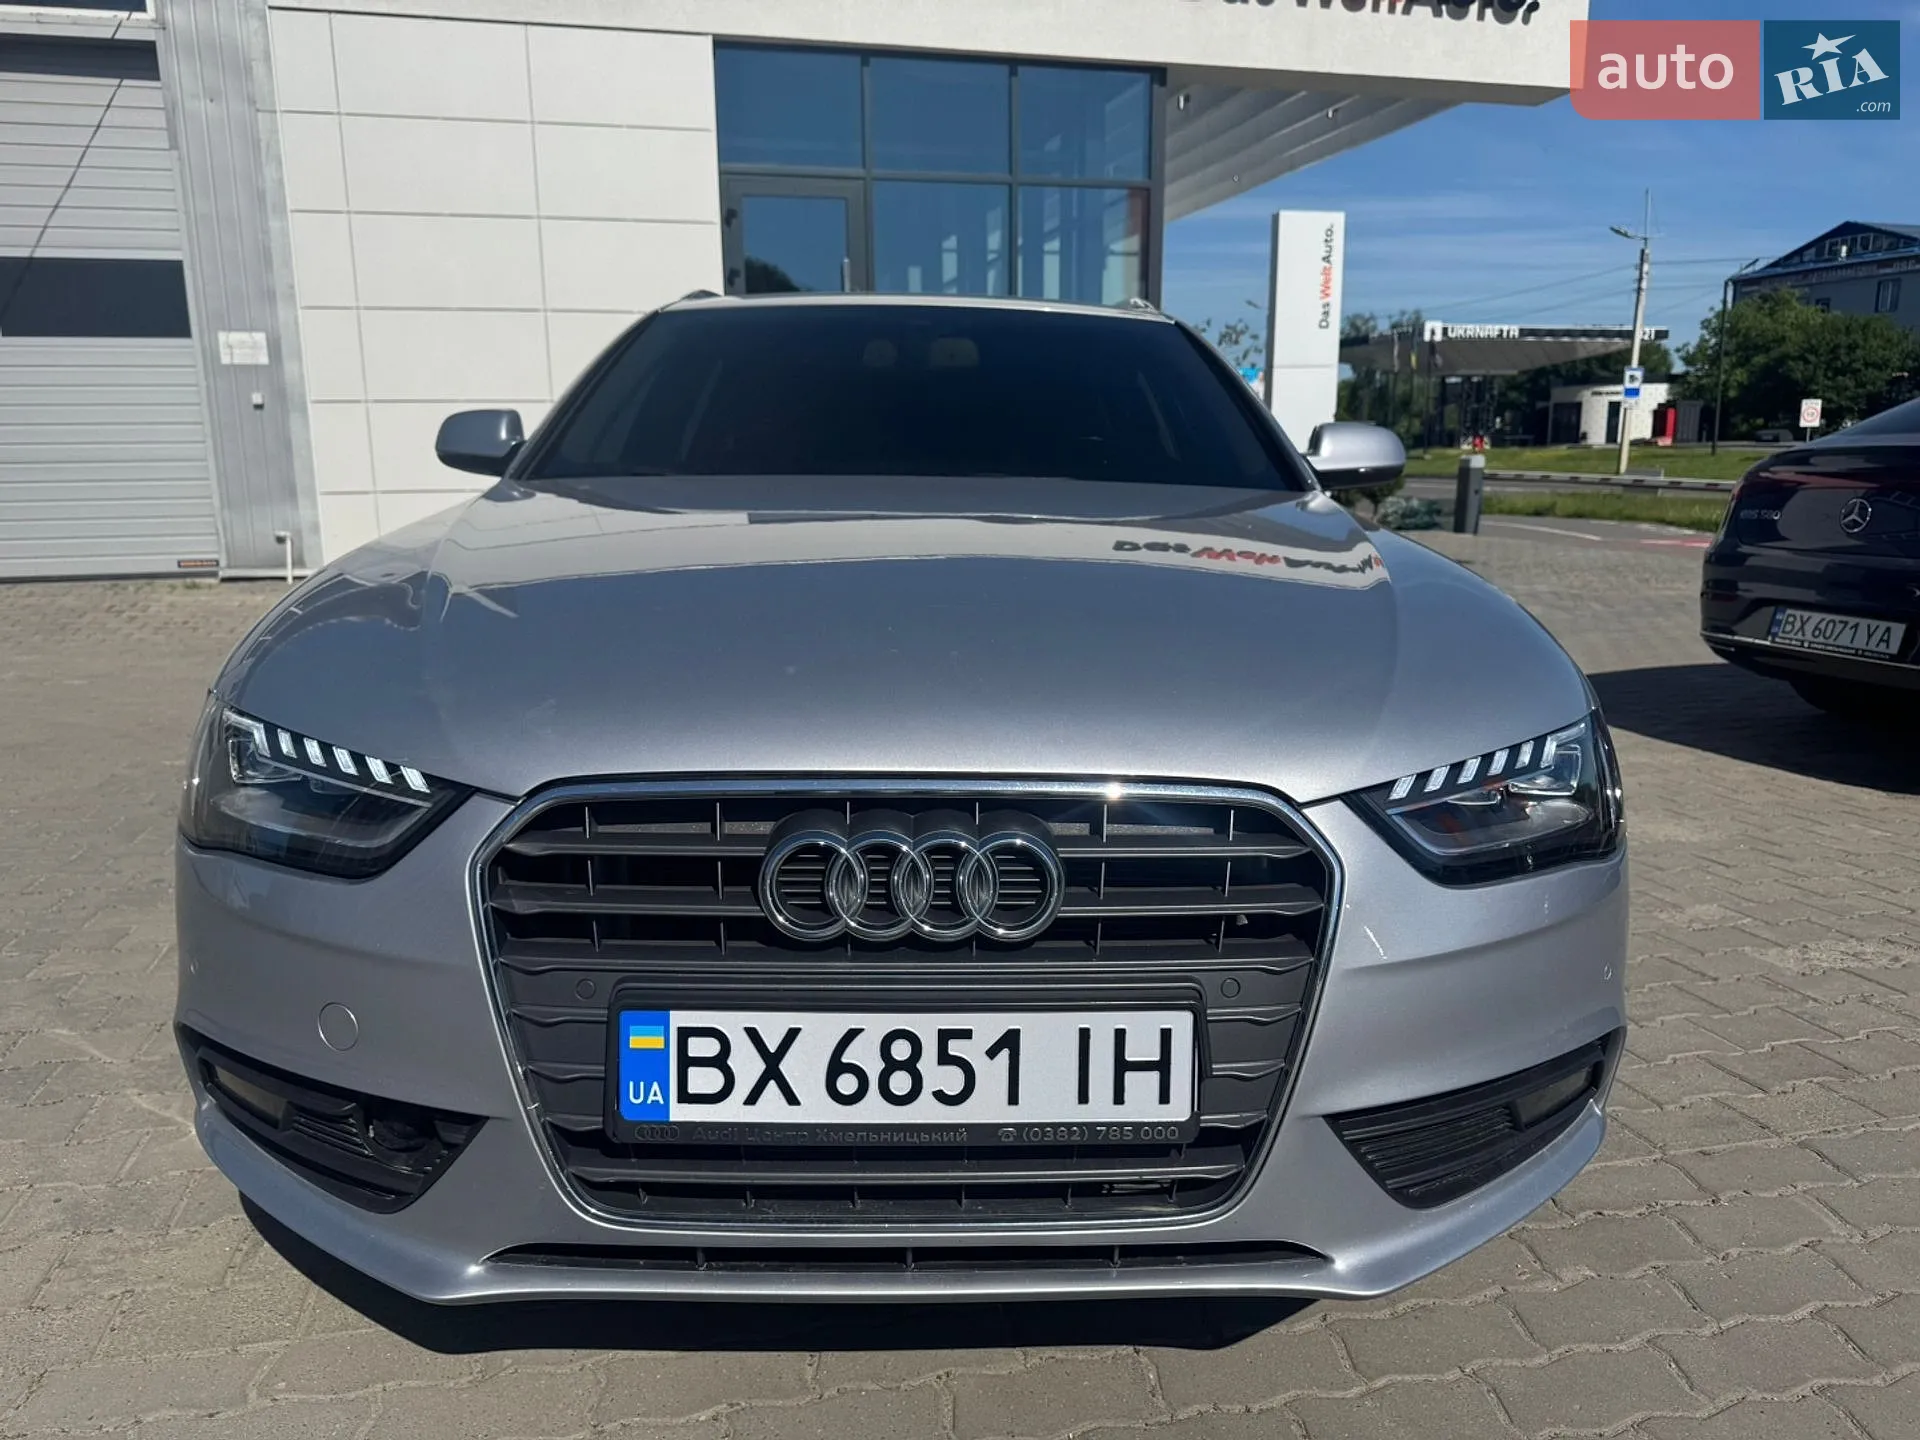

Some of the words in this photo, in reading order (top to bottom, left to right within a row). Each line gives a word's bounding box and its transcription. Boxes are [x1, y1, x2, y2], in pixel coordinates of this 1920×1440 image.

[1318, 302, 1330, 329] Das
[1447, 325, 1520, 339] UKRNAFTA
[1781, 613, 1811, 637] BX
[1811, 619, 1860, 643] 6071
[1865, 624, 1893, 649] YA
[677, 1026, 802, 1106] BX
[825, 1027, 1021, 1106] 6851
[1078, 1027, 1172, 1105] IH
[629, 1081, 664, 1105] UA
[692, 1127, 738, 1141] Audi
[815, 1127, 968, 1143] Хмельницький
[1022, 1127, 1089, 1141] (0382)
[1096, 1127, 1133, 1140] 785
[1140, 1126, 1179, 1140] 000
